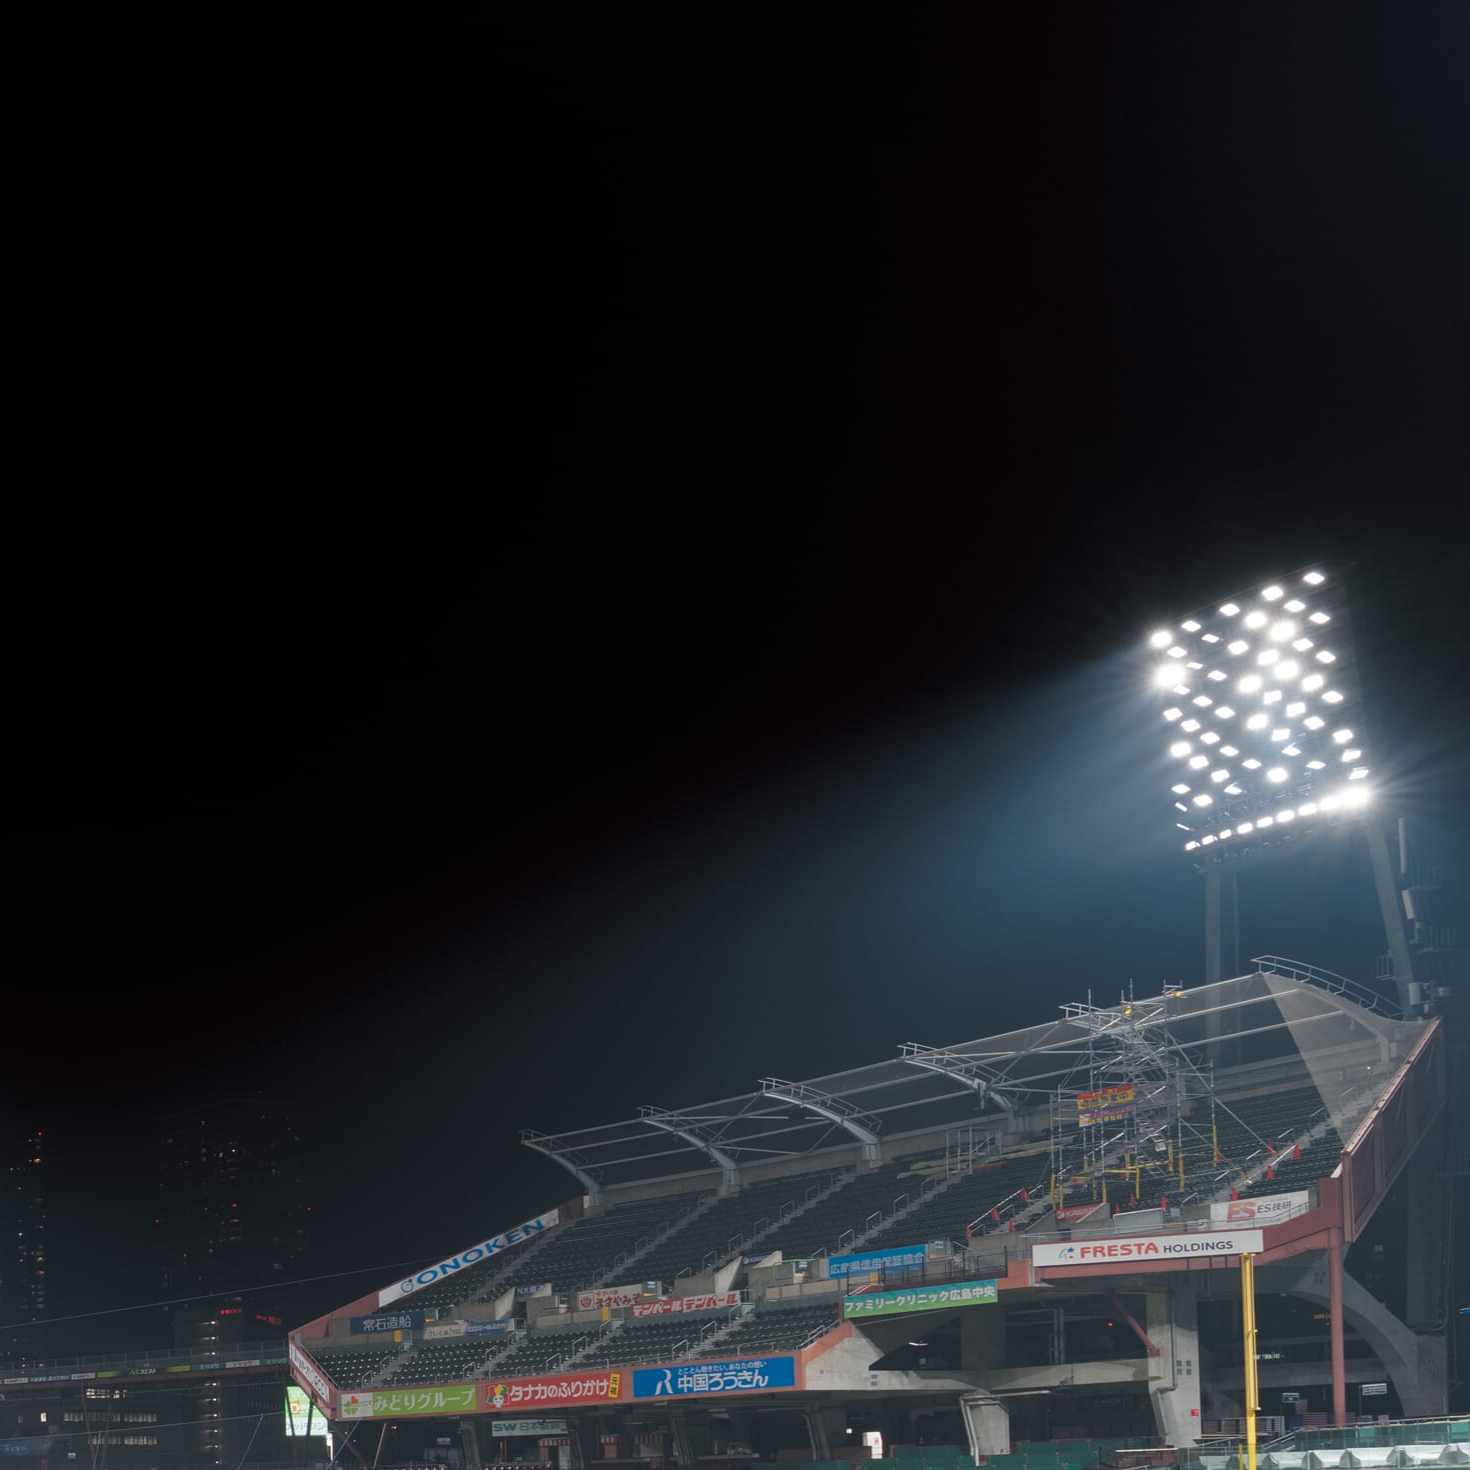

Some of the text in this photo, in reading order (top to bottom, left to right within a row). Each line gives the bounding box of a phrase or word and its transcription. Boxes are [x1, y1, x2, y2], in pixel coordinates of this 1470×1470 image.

[417, 1218, 545, 1286] ONOKEN
[1080, 1240, 1233, 1258] FRESTA HOLDINGS
[632, 1293, 738, 1316] テンパール テンパール
[844, 1286, 995, 1312] ファミリークリニック広島中央
[363, 1317, 411, 1331] 常石造船
[510, 1379, 609, 1401] タナカのふりかけ
[677, 1370, 768, 1392] 中国ろうきん
[374, 1389, 474, 1411] みどりグループ
